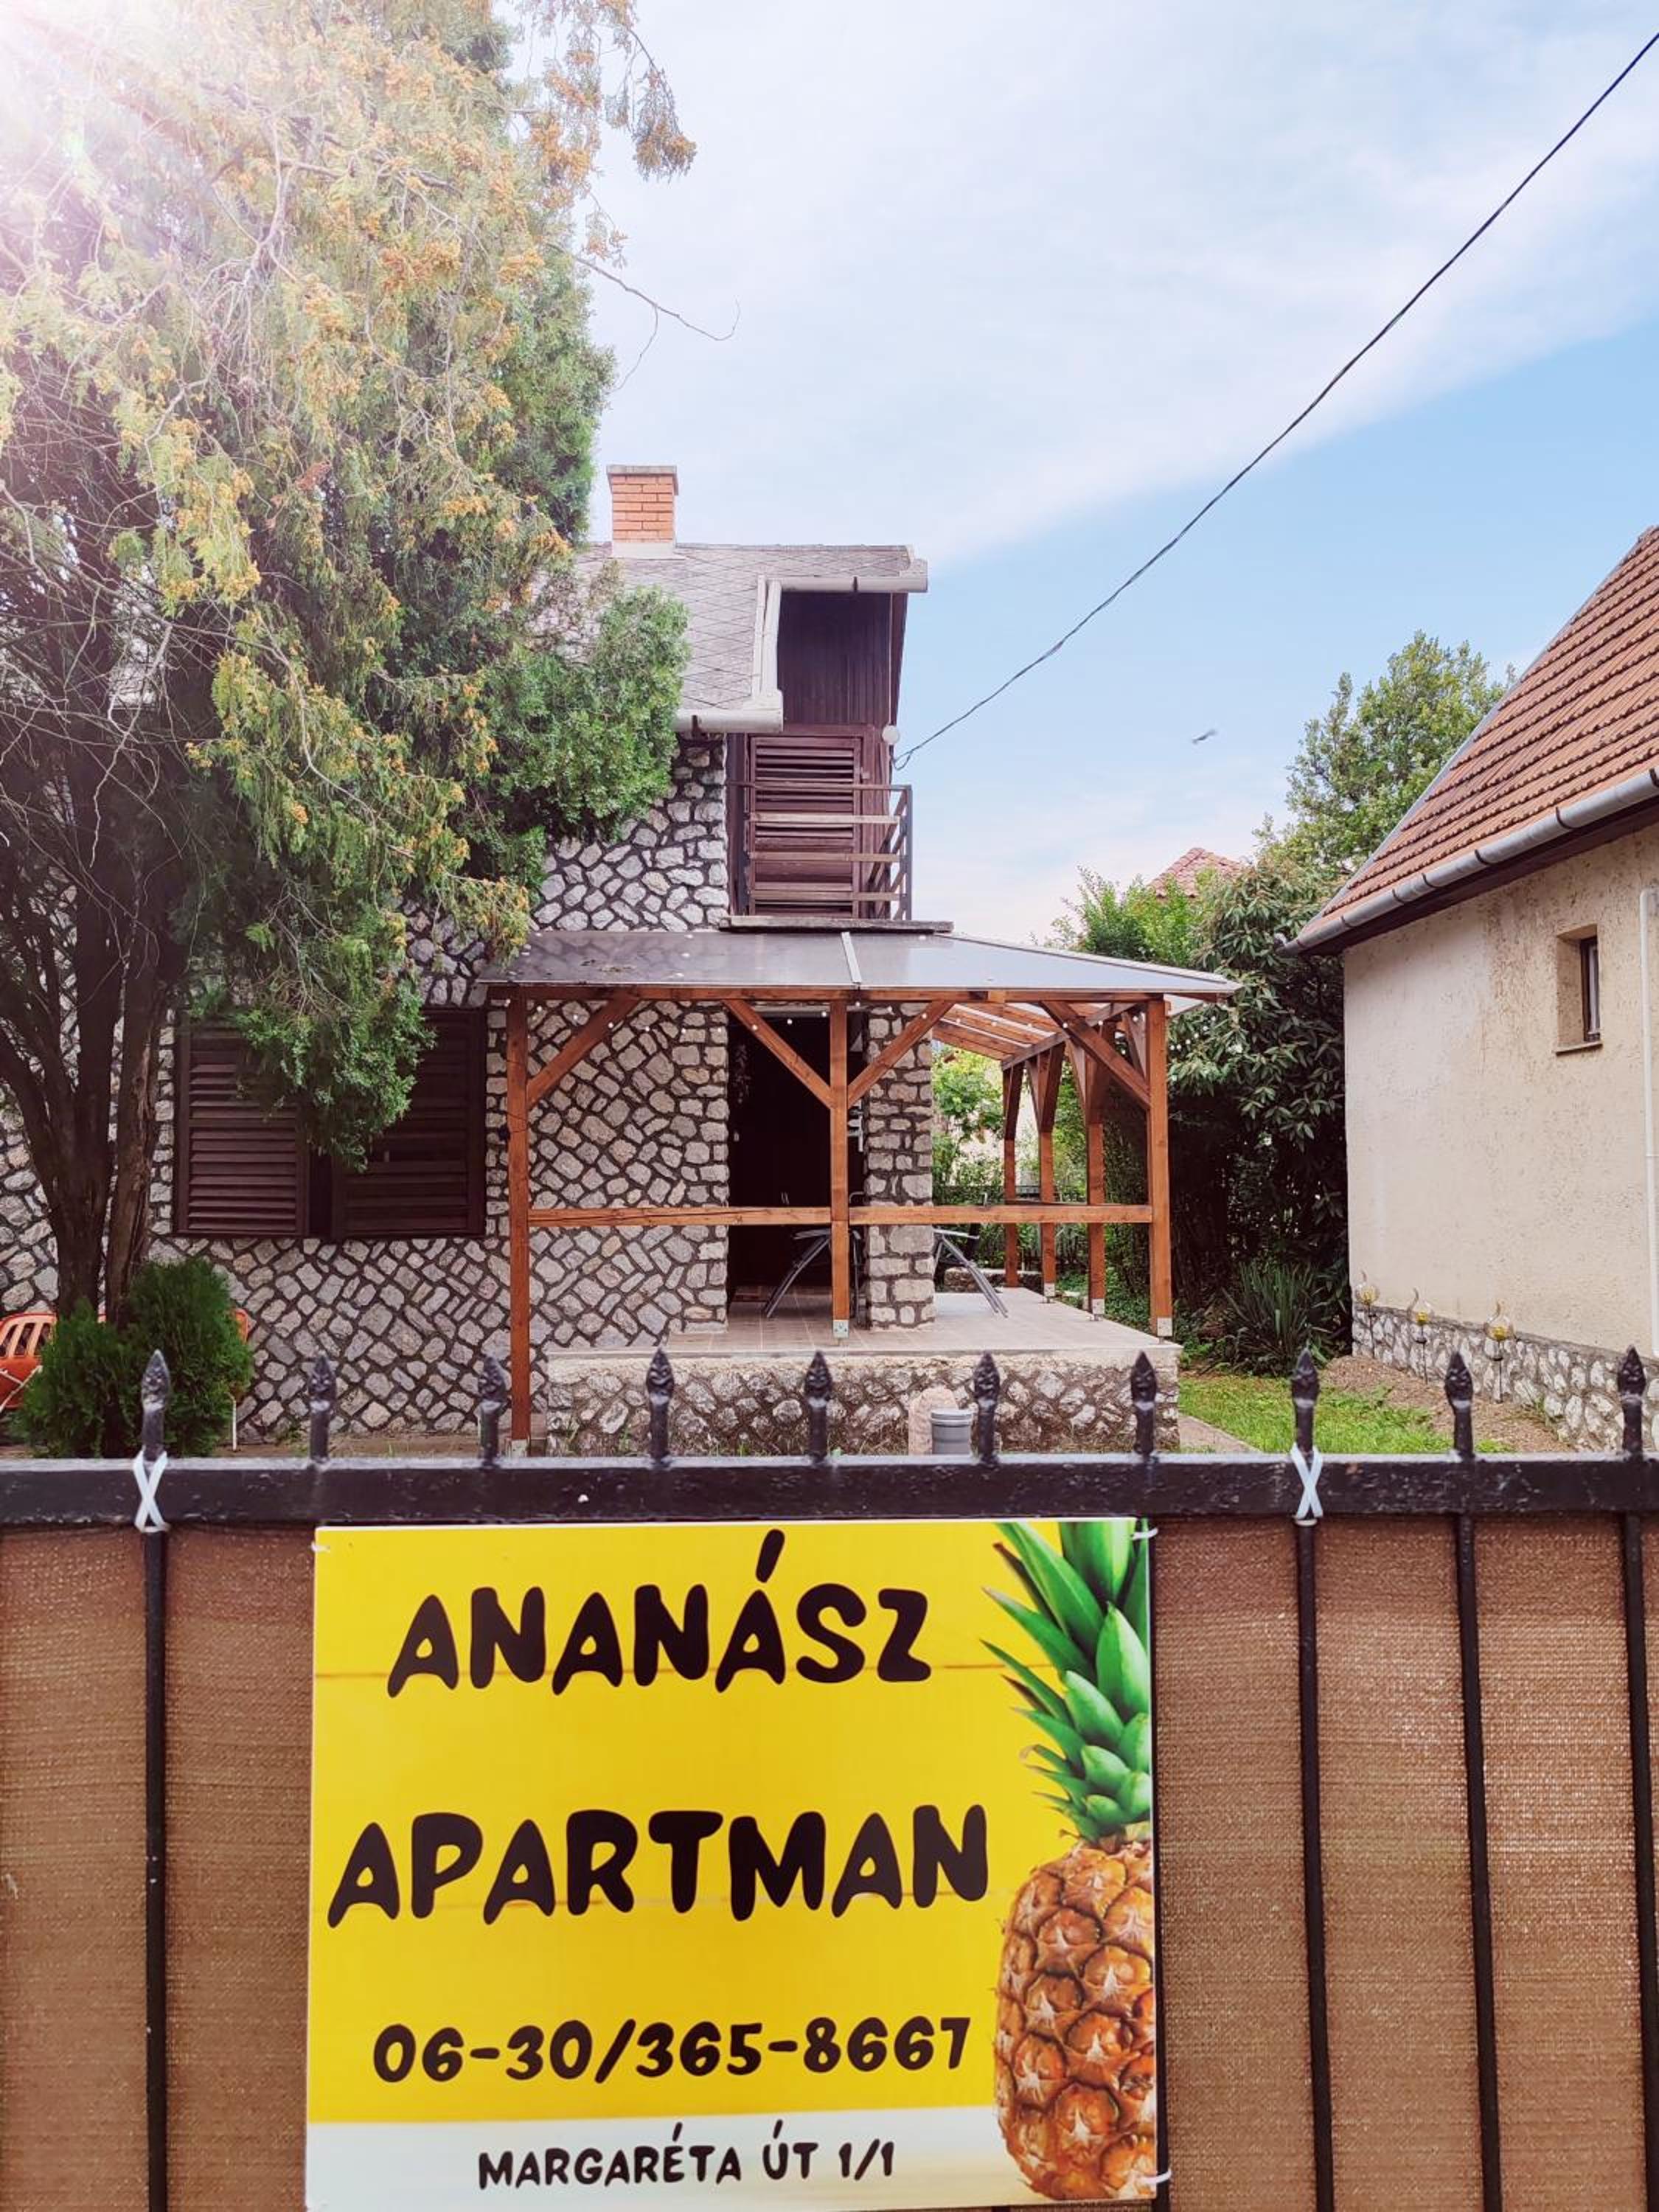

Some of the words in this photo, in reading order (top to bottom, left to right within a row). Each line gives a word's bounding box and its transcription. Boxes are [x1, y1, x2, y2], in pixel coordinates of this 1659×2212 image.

[387, 1529, 932, 1698] ANANÁSZ
[327, 1804, 989, 1929] APARTMAN
[373, 2016, 971, 2084] 06-30/365-8667
[478, 2121, 742, 2190] MARGARÉTA
[762, 2119, 820, 2181] ÚT
[838, 2138, 894, 2181] 1/1
